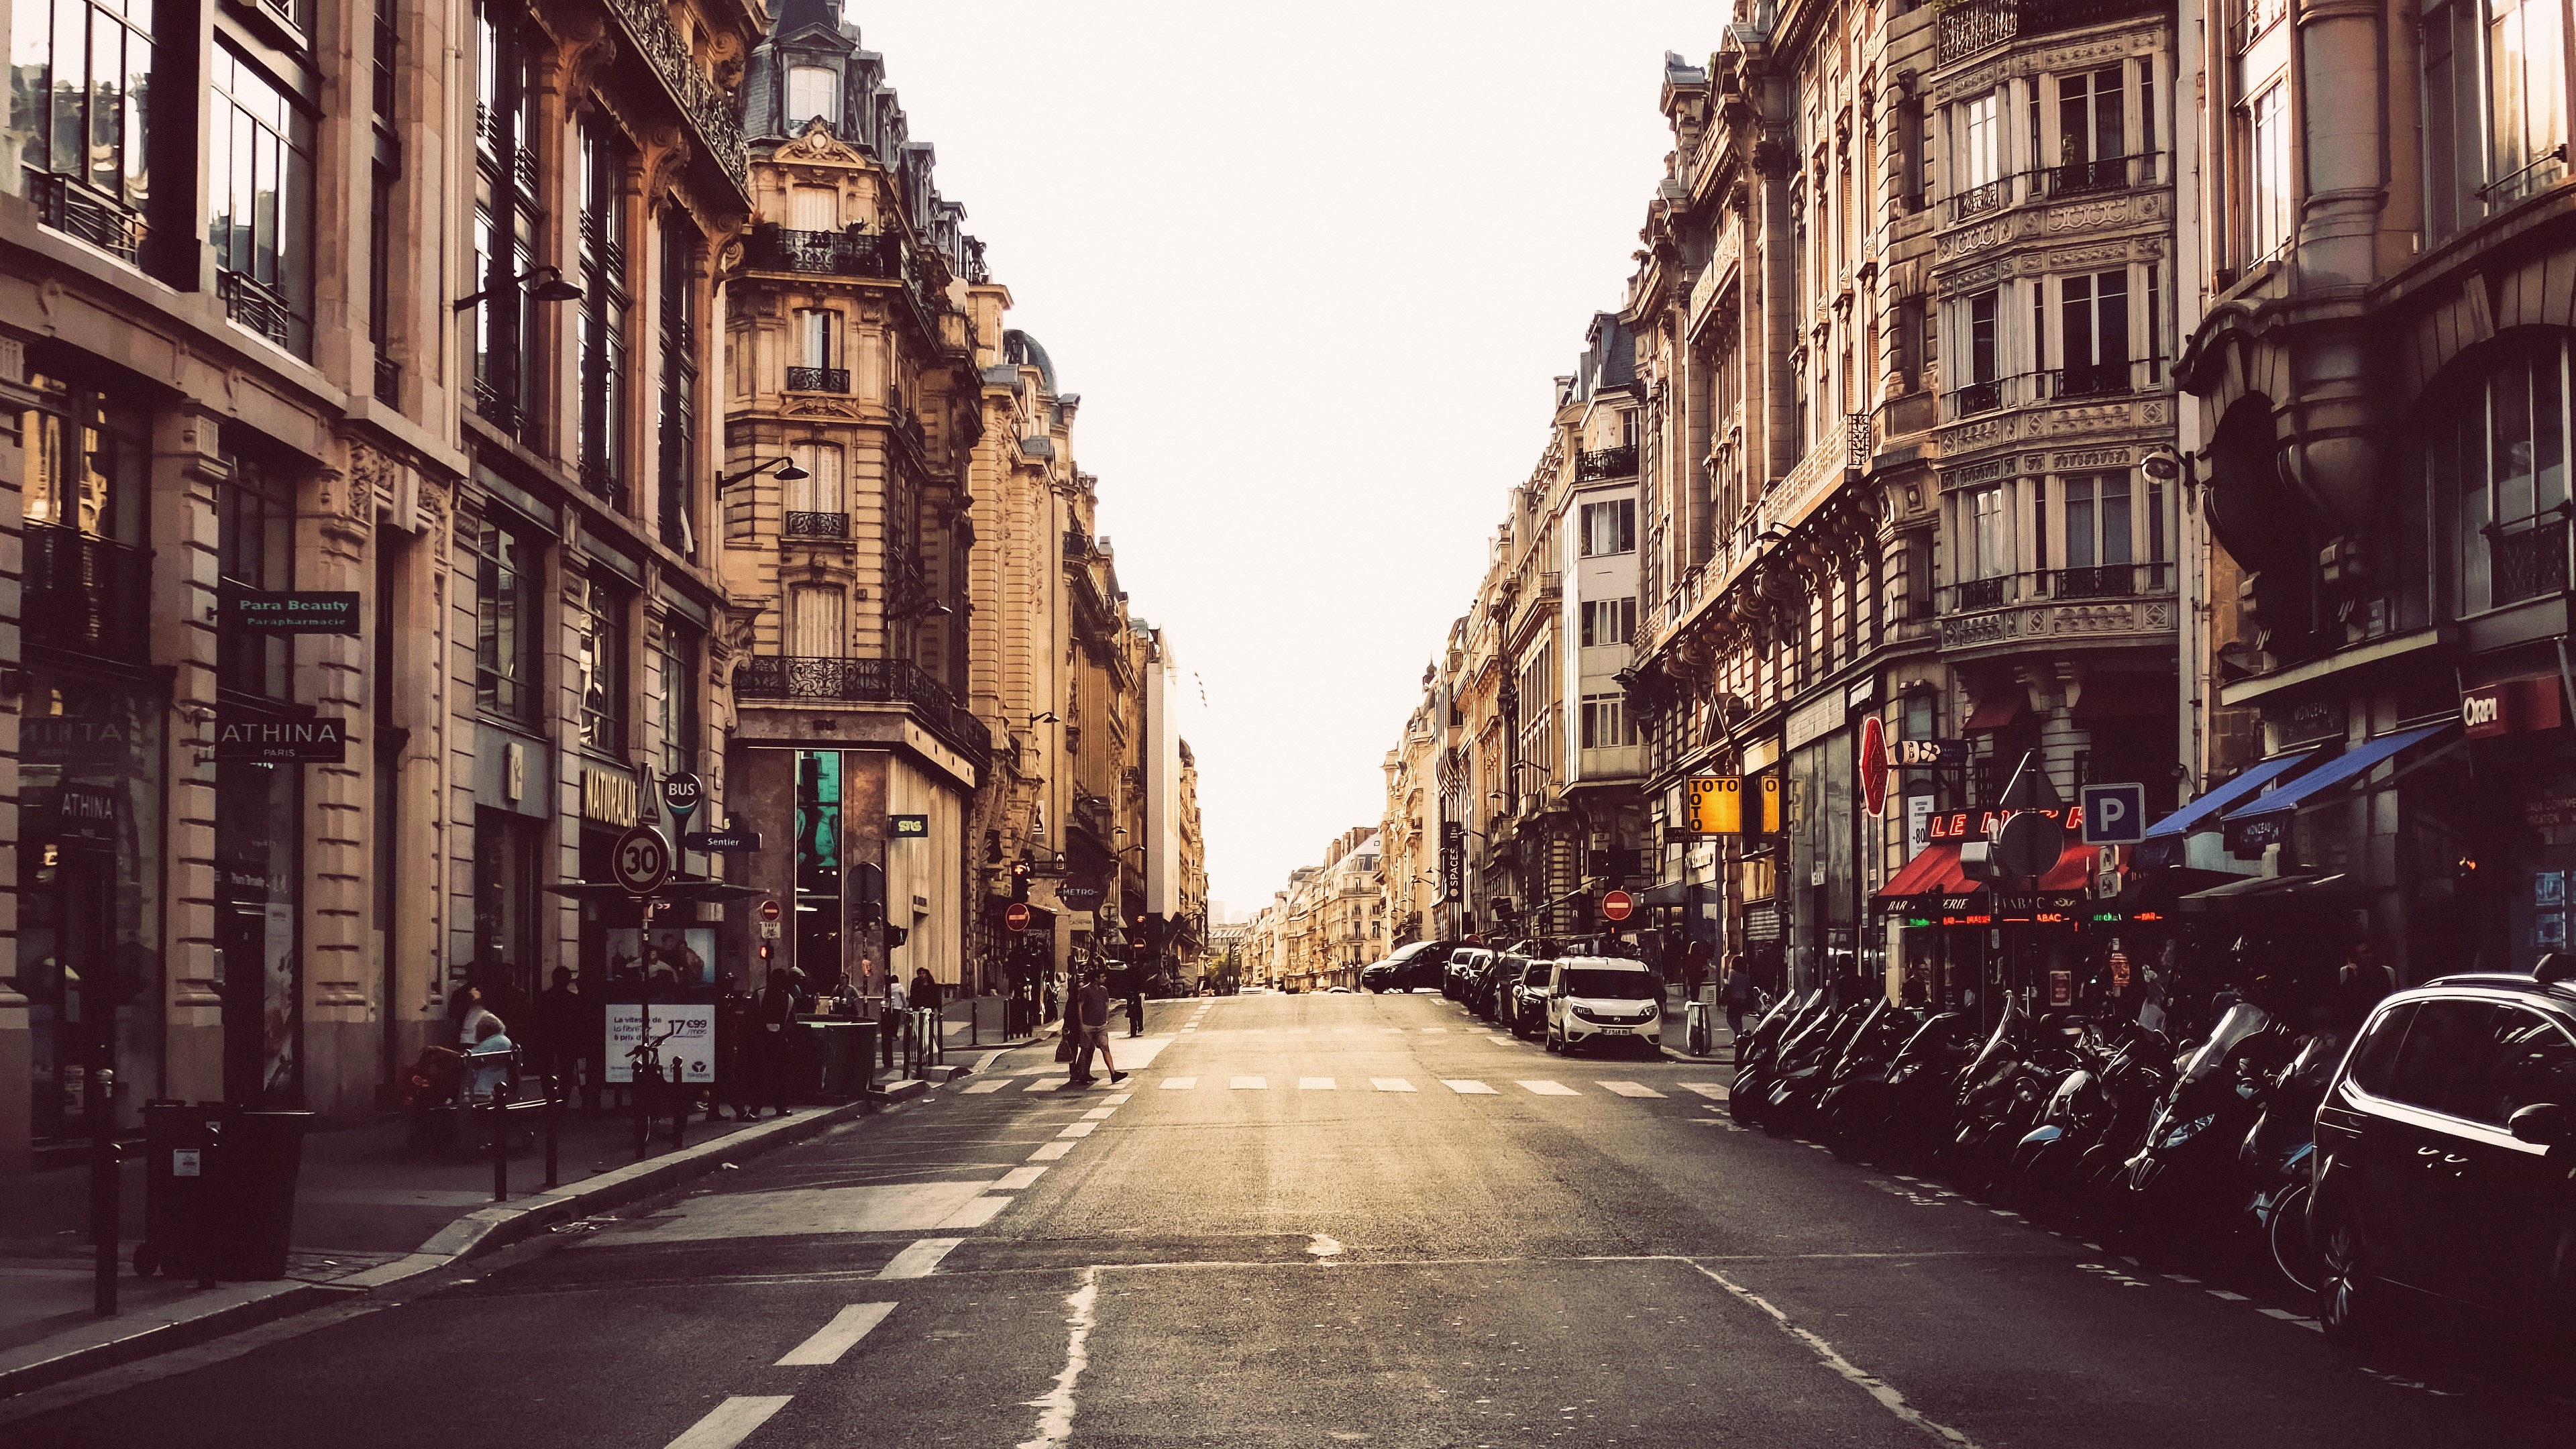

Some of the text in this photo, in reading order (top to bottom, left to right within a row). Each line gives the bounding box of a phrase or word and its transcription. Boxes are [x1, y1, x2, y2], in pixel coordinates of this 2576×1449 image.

[239, 600, 349, 612] Para Beauty
[247, 617, 346, 627] Parapharmacie
[221, 723, 337, 743] ATHINA
[264, 749, 296, 757] PARIS
[669, 782, 696, 796] BUS
[1690, 780, 1738, 792] TOTO
[586, 768, 637, 828] NATURALIA
[61, 793, 113, 820] ATHINA
[2100, 798, 2125, 832] P
[1930, 814, 1966, 837] LE
[707, 838, 740, 847] Sentier
[625, 846, 653, 875] 30
[1887, 900, 1909, 911] BAR
[2037, 913, 2061, 922] ABAC
